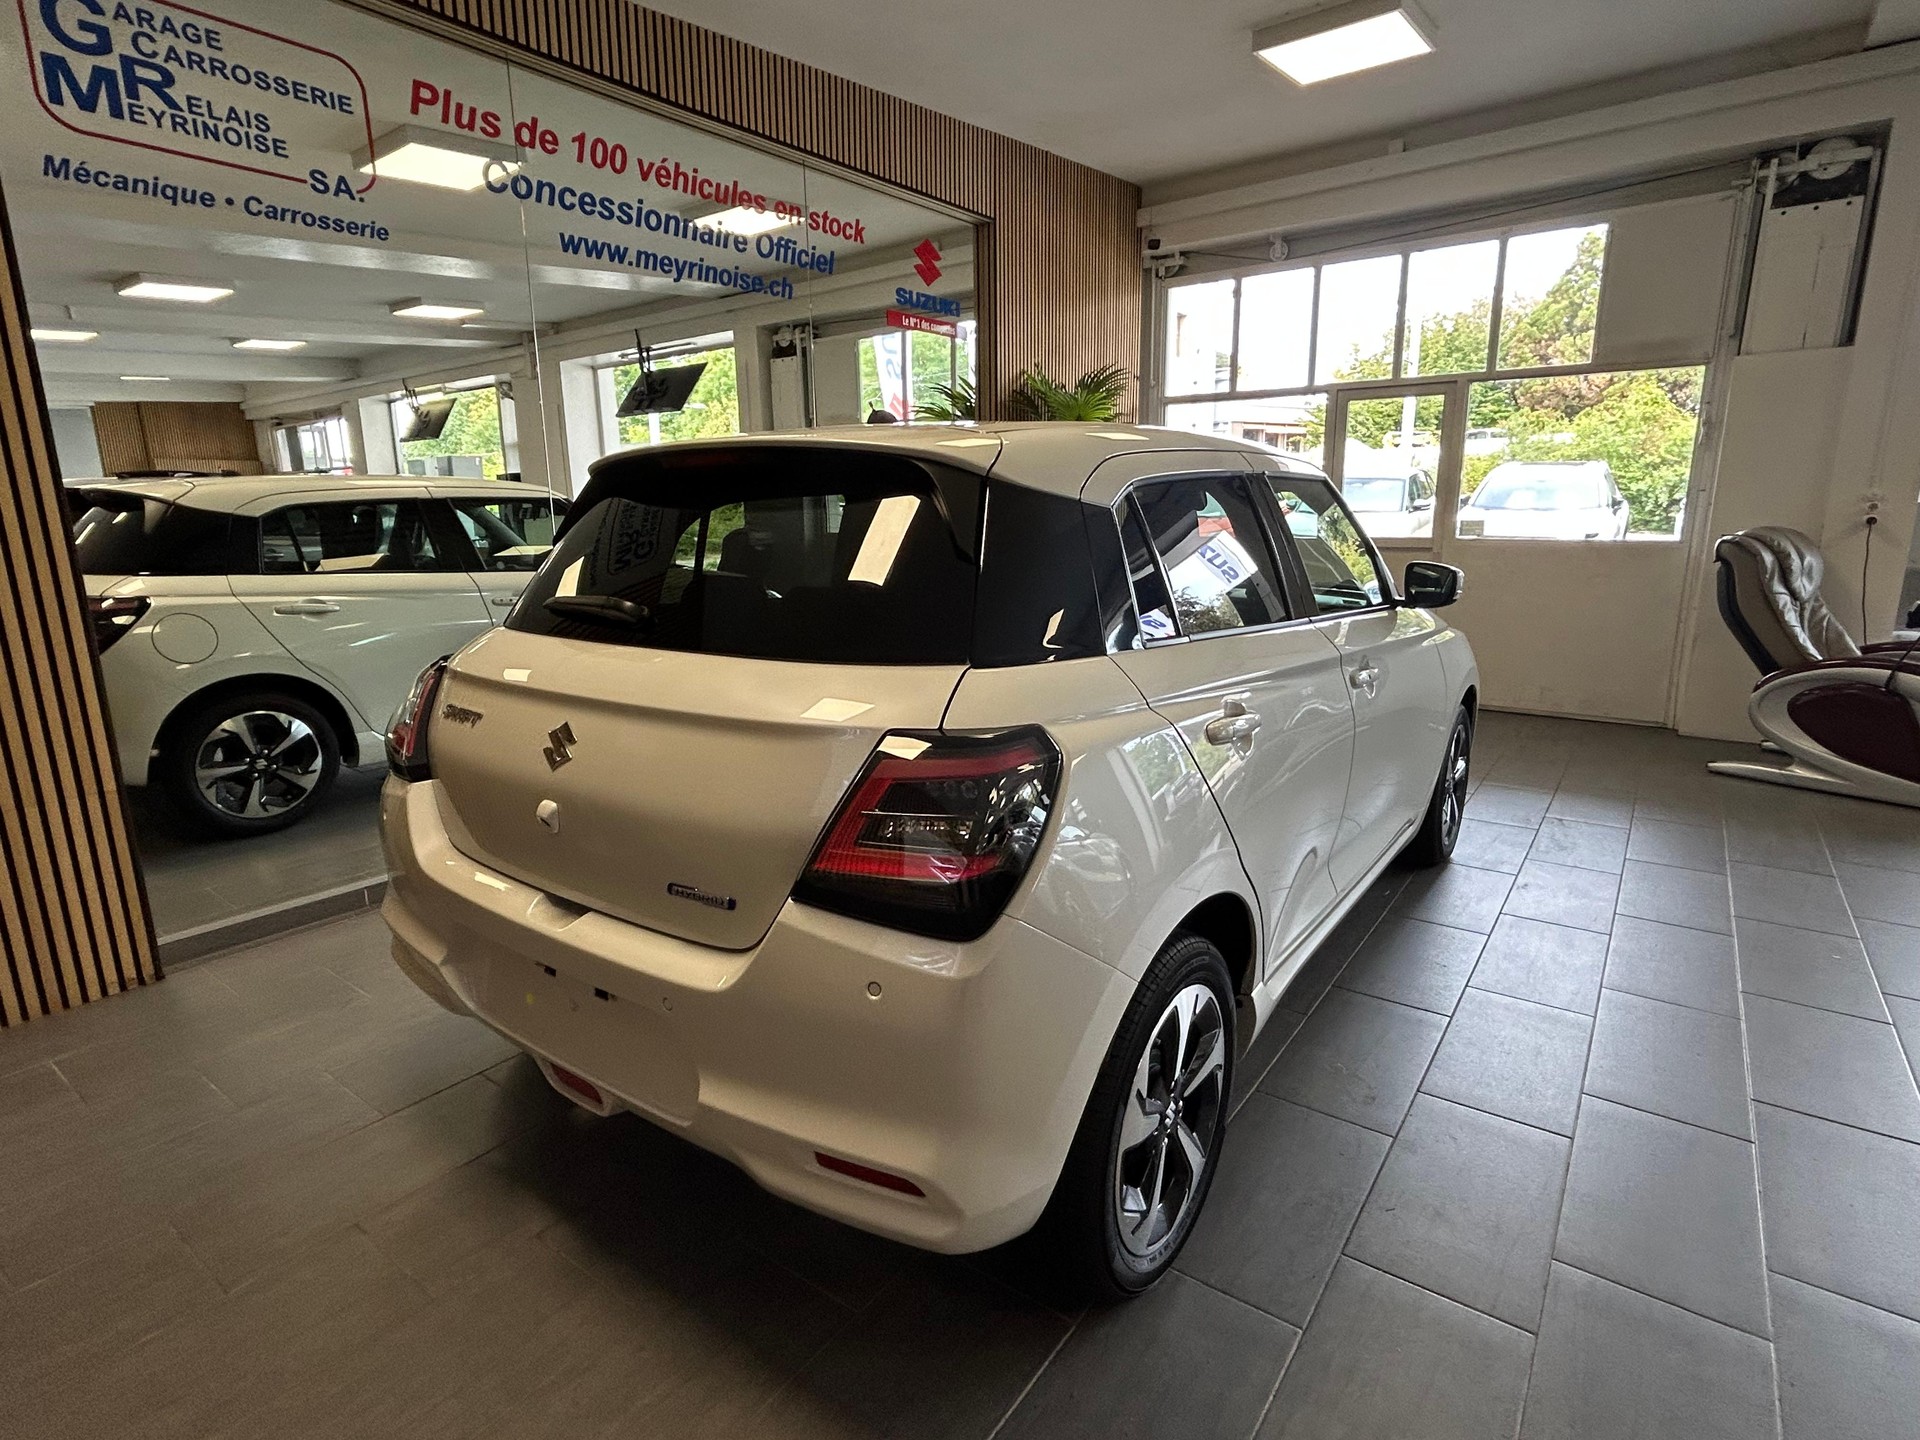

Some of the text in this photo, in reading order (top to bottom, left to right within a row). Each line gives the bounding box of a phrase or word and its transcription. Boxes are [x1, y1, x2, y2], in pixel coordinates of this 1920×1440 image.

[39, 0, 223, 56] GARAGE
[40, 51, 289, 158] MEYRINOISE
[119, 53, 271, 134] RELAIS
[131, 31, 354, 115] CARROSSERIE
[42, 154, 390, 242] Mécanique Carrosserie
[309, 168, 365, 202] SA.
[410, 79, 866, 244] Plus de 100 véhicules en stock
[483, 159, 835, 275] Concessionnaire Officiel
[559, 232, 794, 300] www.meyrinoise.ch
[895, 287, 960, 317] SUZUKI
